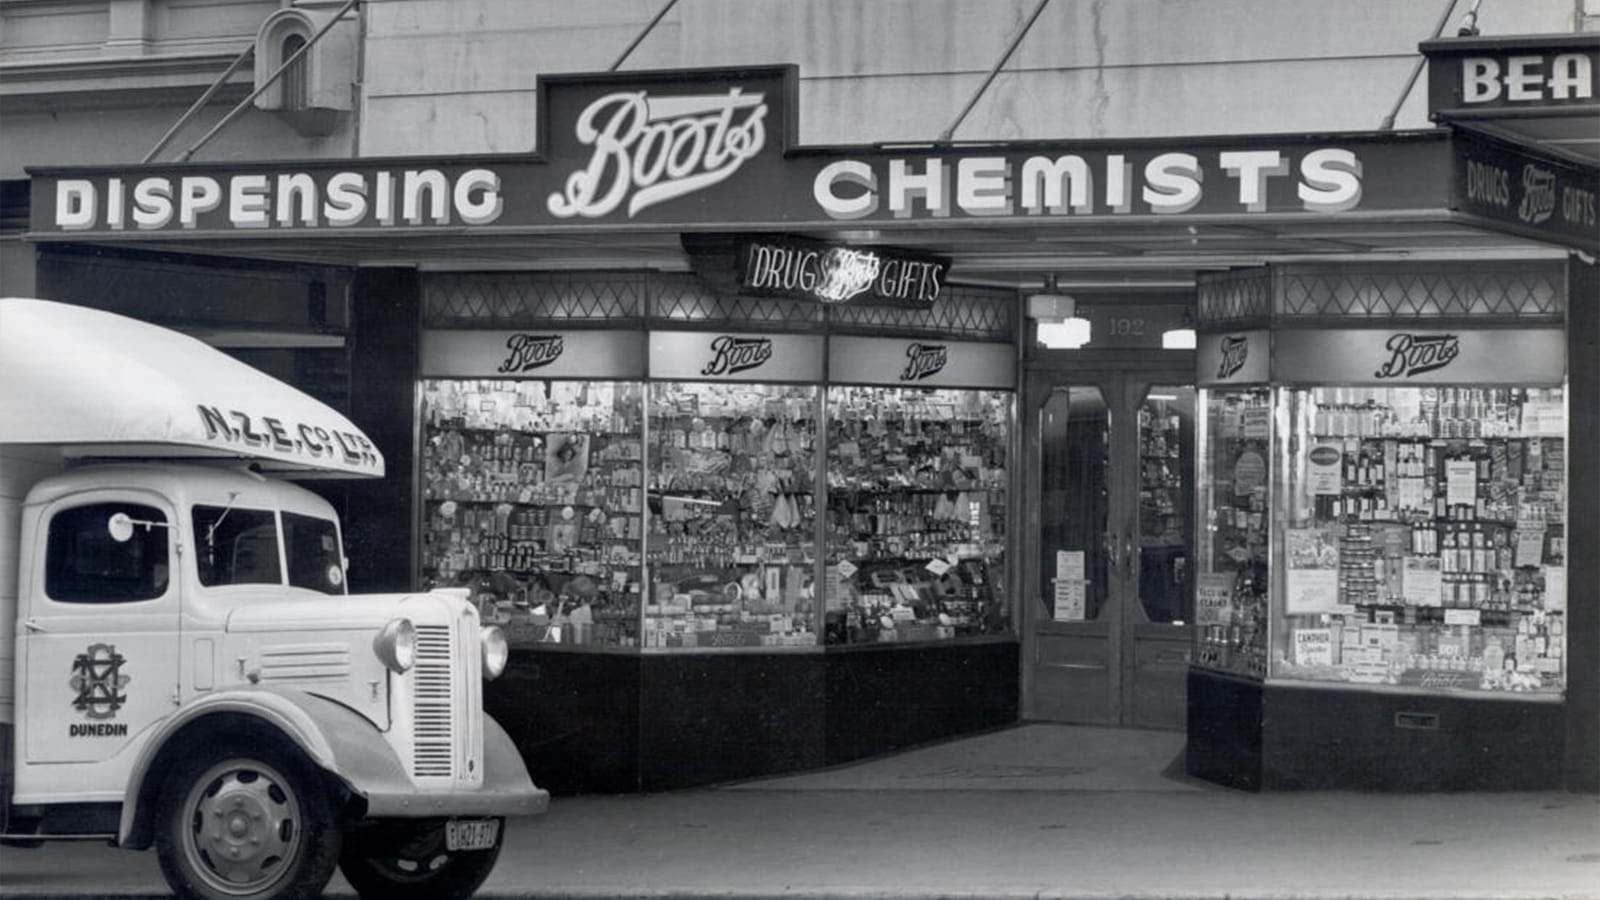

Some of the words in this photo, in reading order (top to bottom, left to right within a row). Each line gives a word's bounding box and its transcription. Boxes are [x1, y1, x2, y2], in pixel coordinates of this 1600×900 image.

[1462, 53, 1592, 103] BEA
[547, 87, 768, 219] Boots
[55, 168, 503, 231] DISPENSING
[813, 148, 1363, 219] CHEMISTS
[1467, 160, 1510, 208] DRUGS
[1518, 164, 1556, 224] Boots
[1563, 186, 1596, 226] GIFTS
[881, 260, 943, 301] GIFTS
[1109, 318, 1145, 336] 192
[497, 333, 564, 373] Boots
[701, 336, 773, 376] Boots
[900, 342, 948, 381] Boots
[1374, 333, 1459, 378] Boots
[70, 723, 128, 737] DUNEDIN
